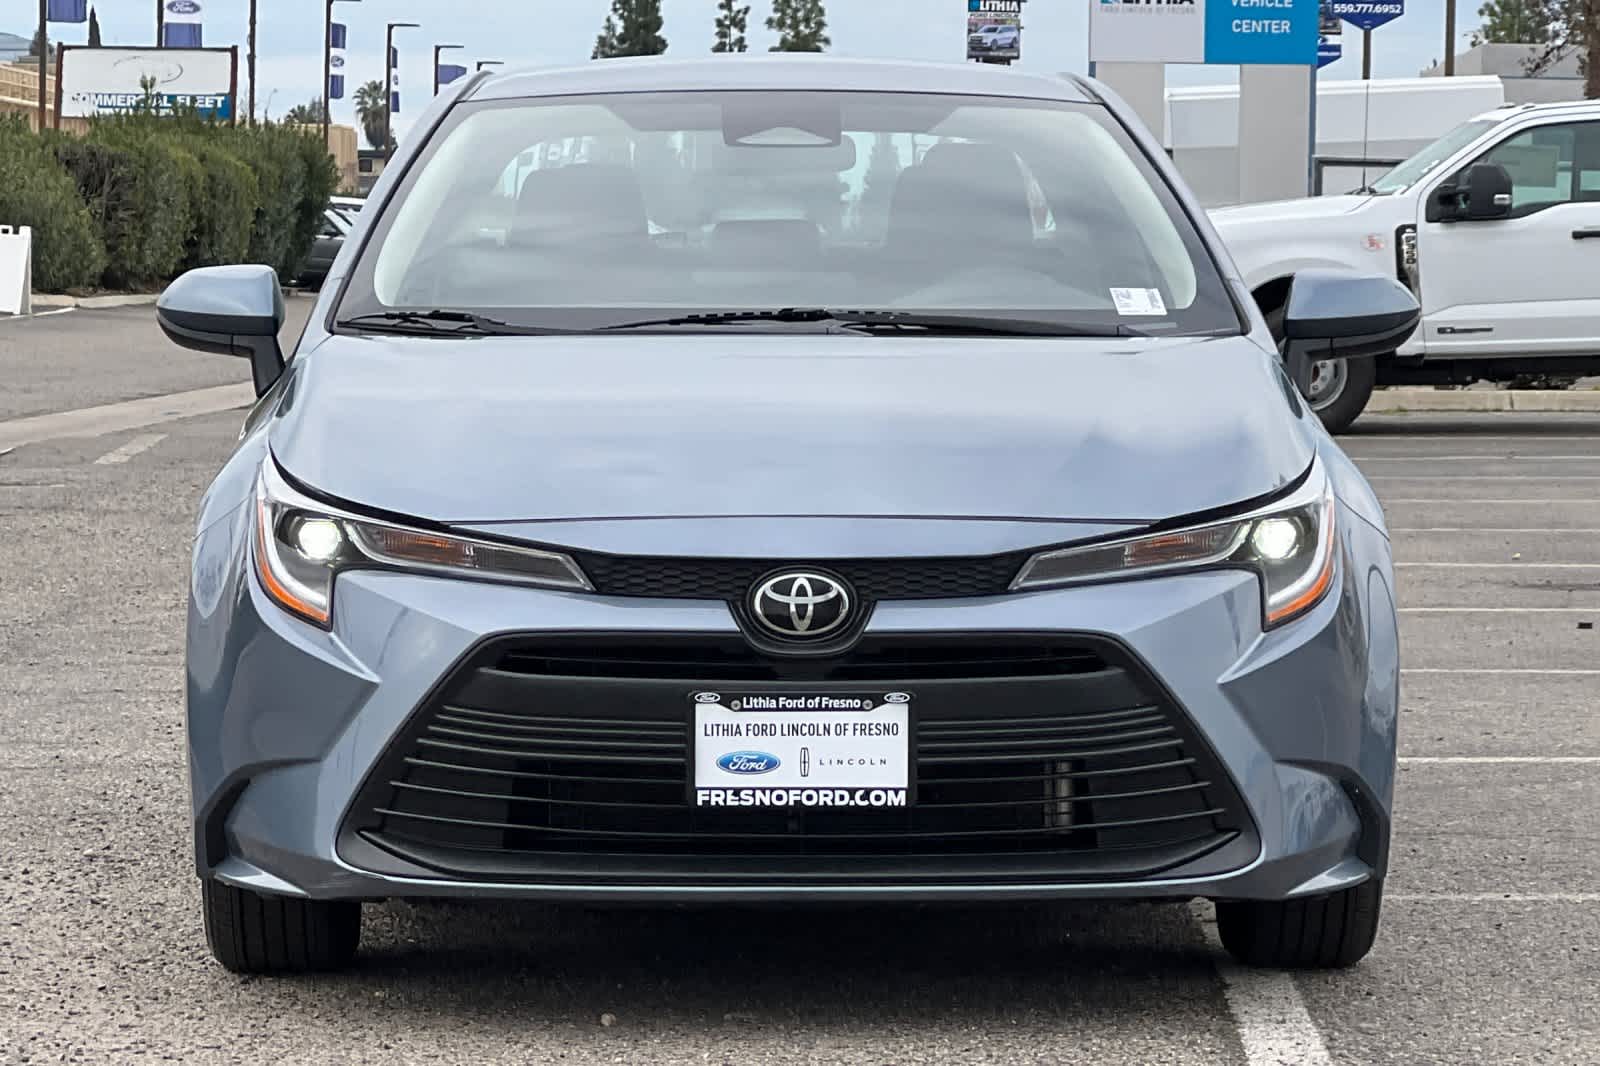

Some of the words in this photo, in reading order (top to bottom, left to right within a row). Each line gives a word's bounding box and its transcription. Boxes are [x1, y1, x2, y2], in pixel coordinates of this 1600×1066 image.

[980, 0, 1019, 11] LITHIA
[1231, 0, 1293, 8] VEHICLE
[1333, 3, 1402, 13] 559.777.6952
[1231, 19, 1291, 33] CENTER
[72, 94, 172, 108] OMMERAL
[743, 697, 777, 709] Lithia
[779, 697, 805, 709] Ford
[807, 697, 820, 709] of
[822, 697, 861, 709] Fresno
[704, 723, 742, 737] LITHIA
[746, 723, 777, 737] FORD
[781, 723, 831, 737] LINCOLN
[834, 723, 849, 737] OF
[853, 722, 899, 736] FRESNO
[728, 754, 769, 771] Ford
[819, 758, 887, 766] LINCOLN
[697, 789, 906, 806] FRESNOFORD.COM
